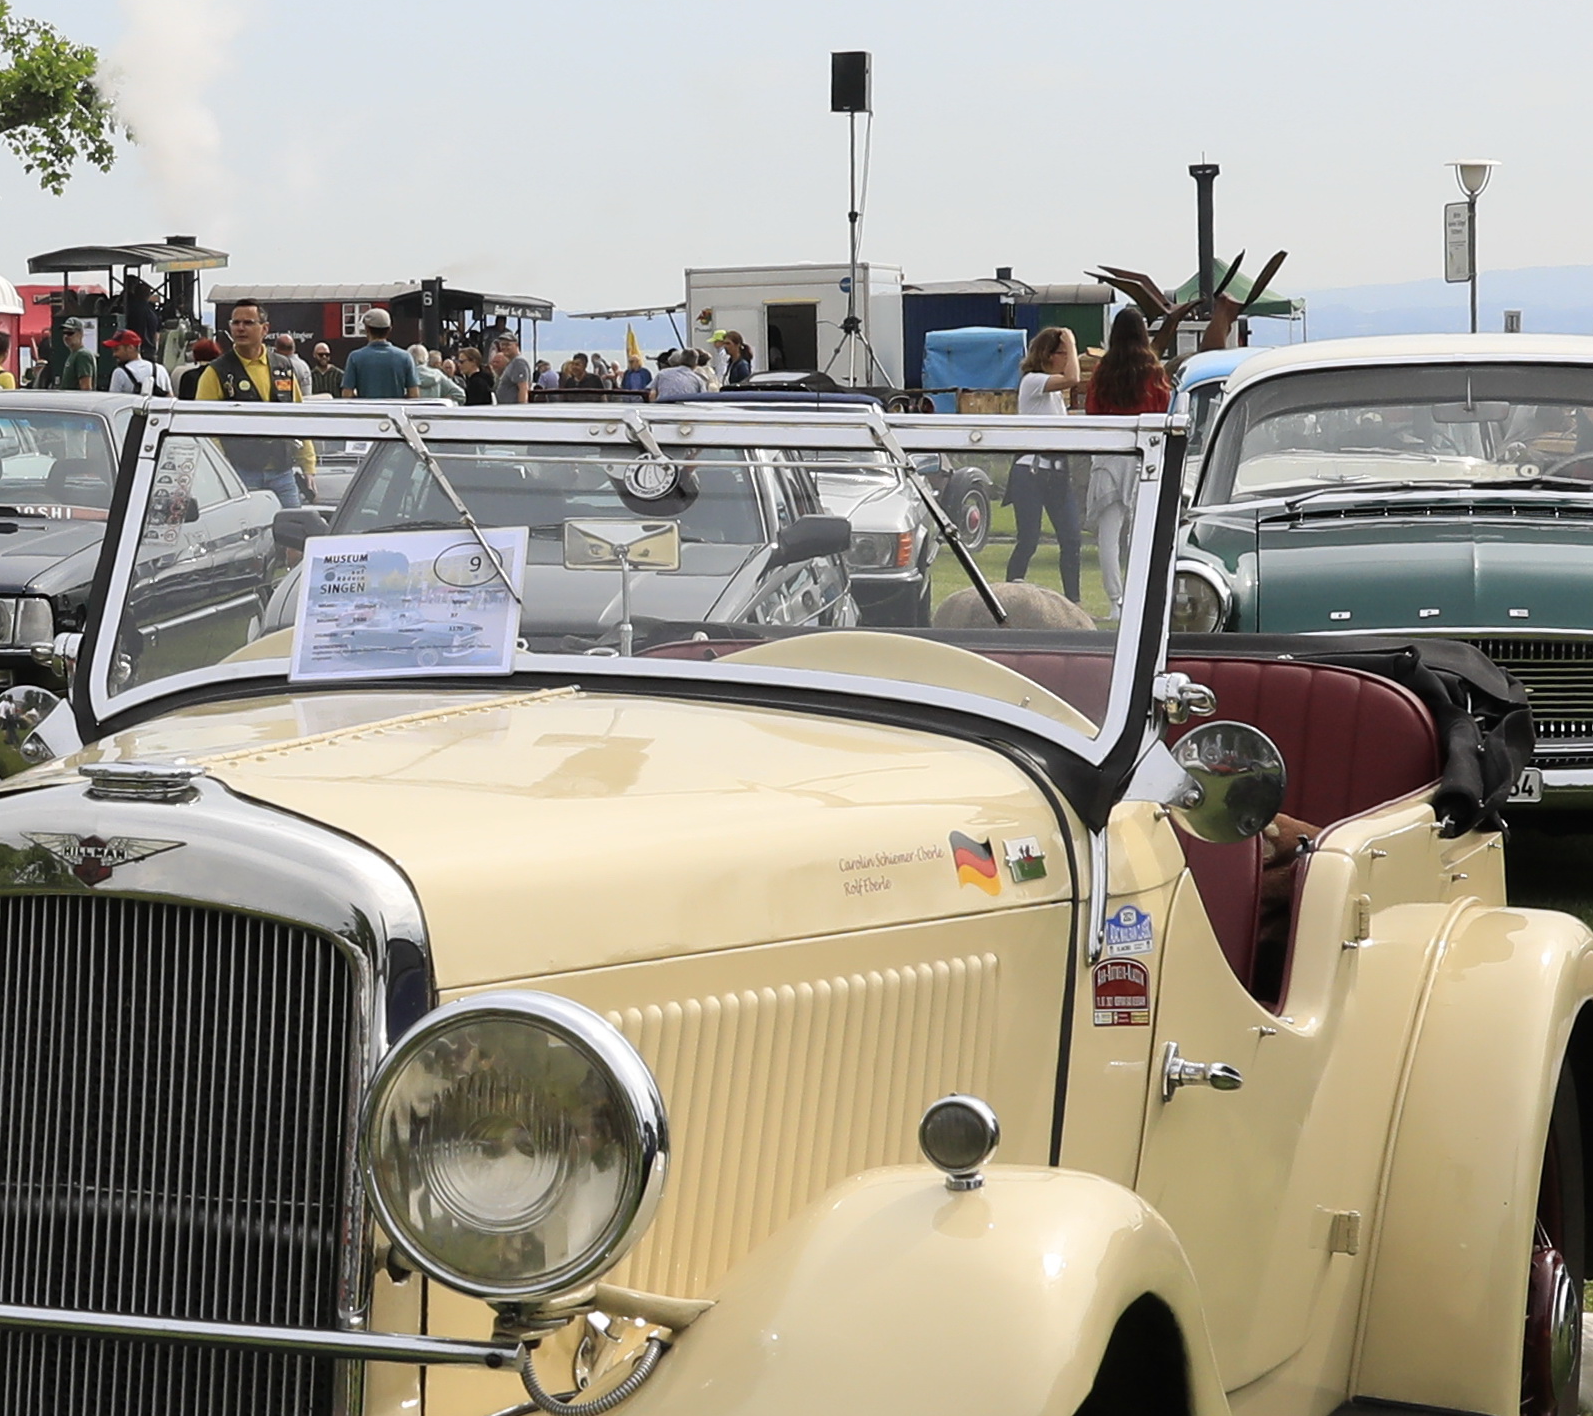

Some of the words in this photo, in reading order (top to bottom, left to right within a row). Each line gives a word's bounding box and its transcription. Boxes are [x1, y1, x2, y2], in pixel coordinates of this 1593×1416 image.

[423, 291, 433, 306] 6
[323, 553, 369, 564] MUSEUM
[469, 555, 483, 573] 9
[319, 582, 366, 595] SINGEN
[64, 847, 128, 860] HILLMAN
